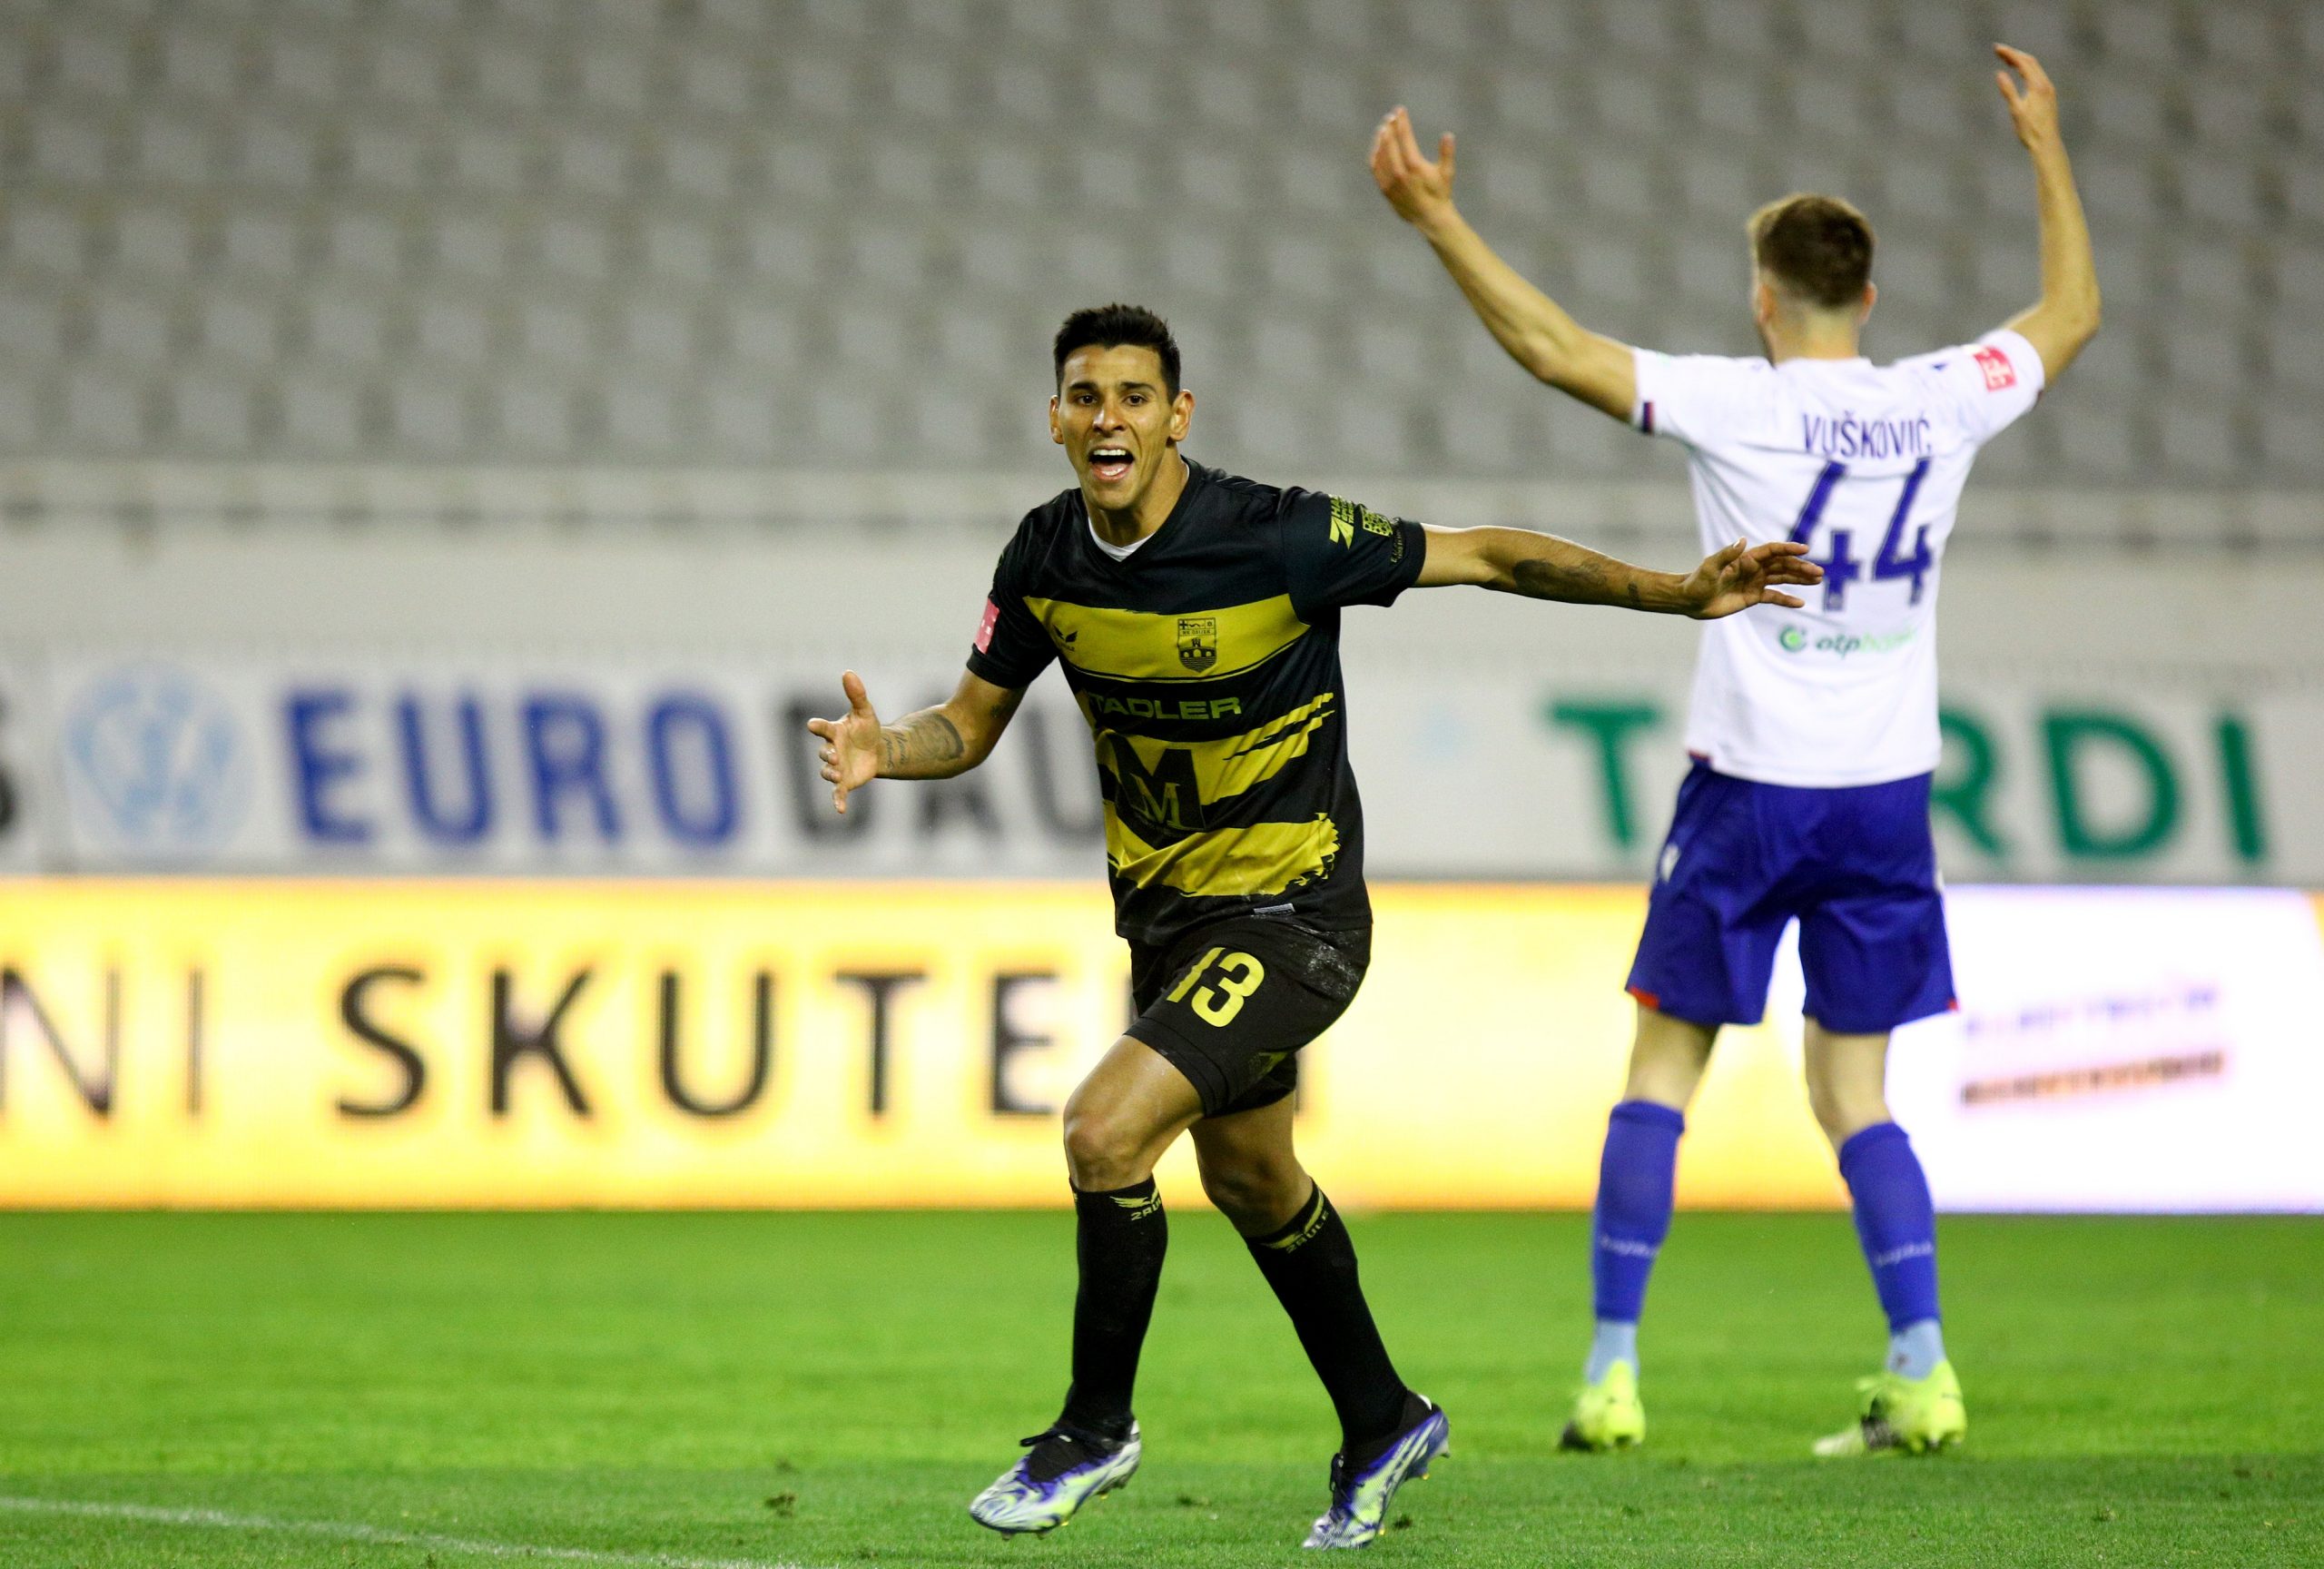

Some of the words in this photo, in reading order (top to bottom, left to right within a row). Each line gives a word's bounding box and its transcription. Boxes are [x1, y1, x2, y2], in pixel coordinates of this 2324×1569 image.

[1788, 456, 1932, 612] 44
[1088, 693, 1242, 720] TADLER
[338, 964, 1135, 1119] SKUTE
[1166, 947, 1265, 1028] 13
